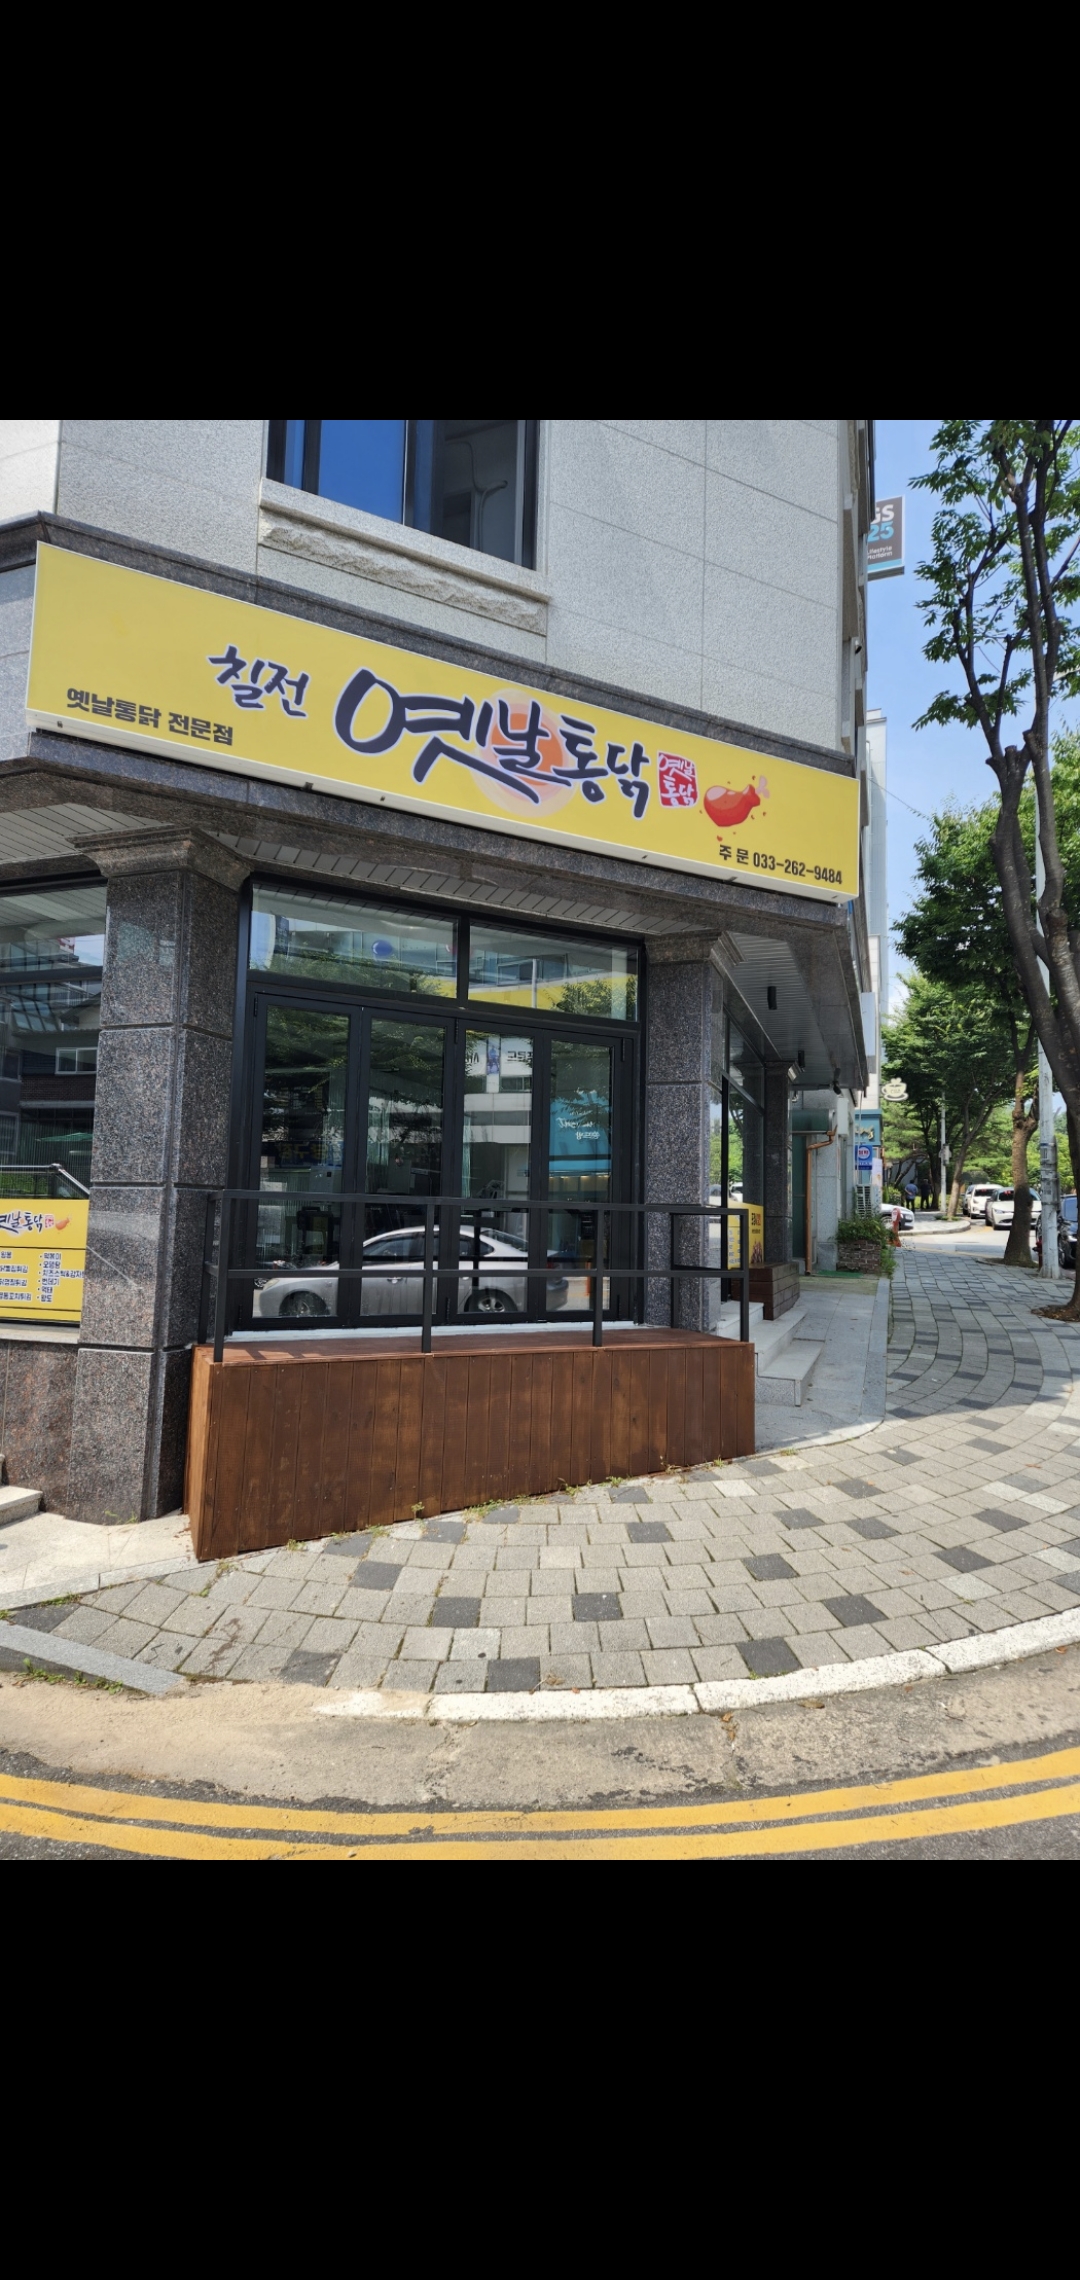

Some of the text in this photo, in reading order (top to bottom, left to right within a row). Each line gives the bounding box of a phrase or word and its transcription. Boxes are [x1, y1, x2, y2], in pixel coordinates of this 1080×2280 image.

[868, 521, 895, 542] 25
[867, 546, 893, 556] ifestyle
[66, 688, 233, 746] 옛날통닭 전문점
[208, 645, 650, 819] 칠전 옛날통닭
[658, 754, 696, 782] 옛날
[660, 775, 696, 807] 통닭
[753, 852, 843, 885] 033-262-9484
